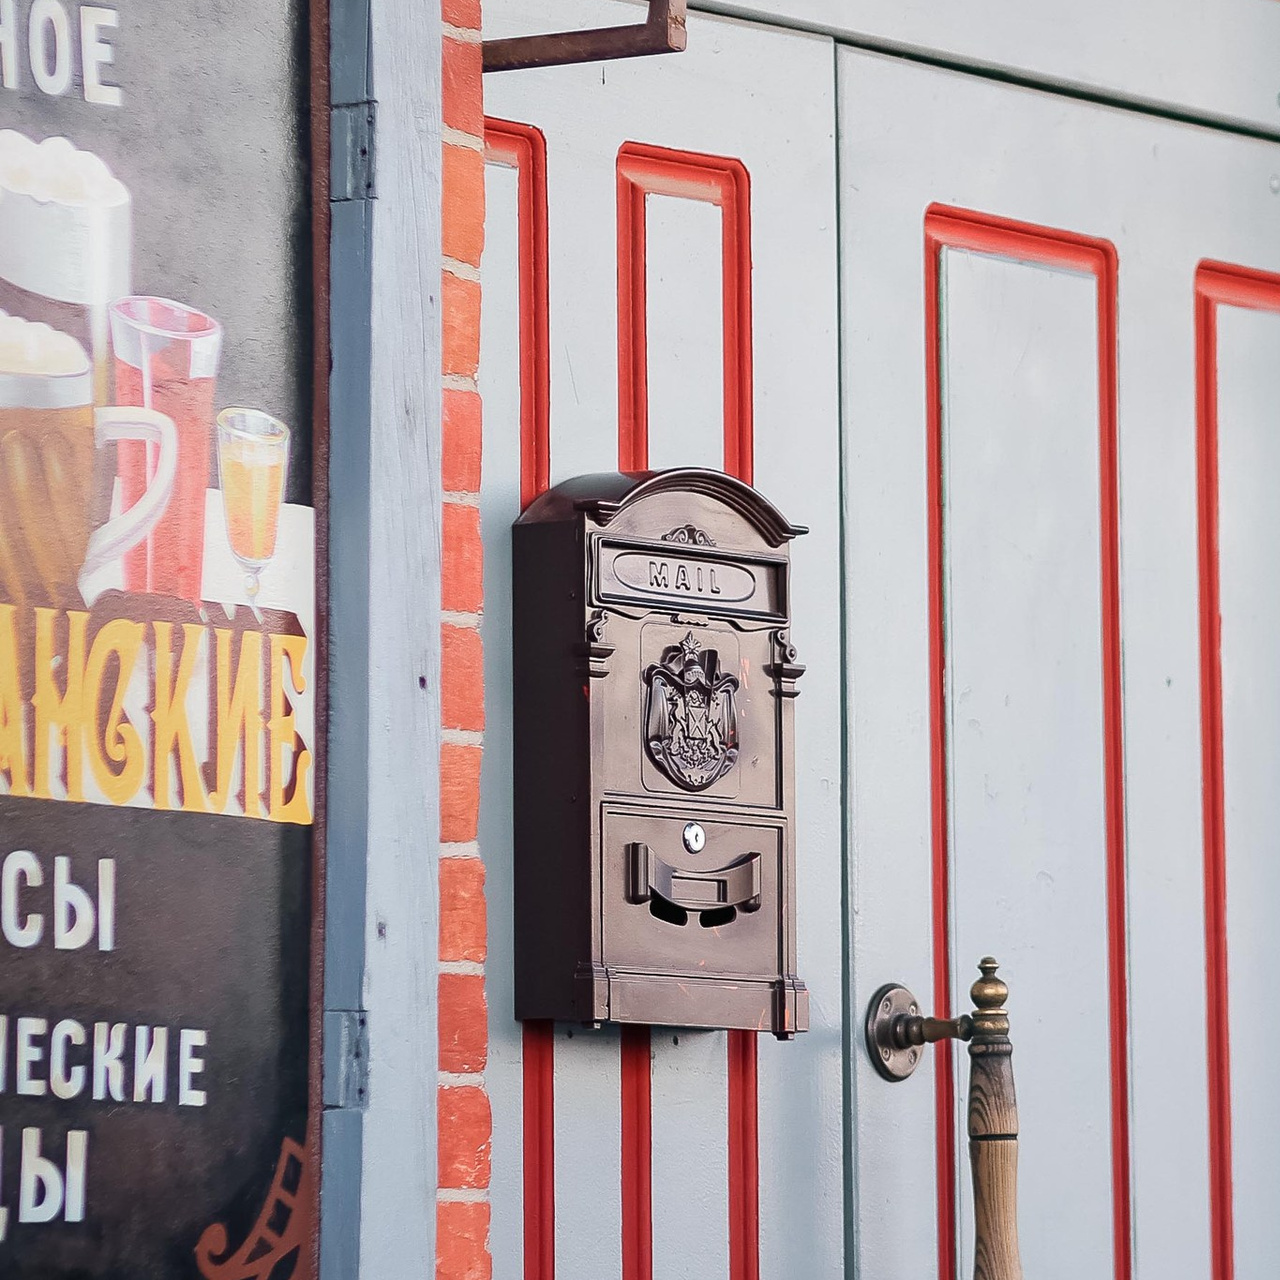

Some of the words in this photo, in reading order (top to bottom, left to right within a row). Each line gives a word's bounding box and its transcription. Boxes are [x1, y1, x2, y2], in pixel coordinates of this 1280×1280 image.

[648, 560, 721, 595] MAIL
[0, 1012, 208, 1108] ЕСКИЕ
[0, 1124, 89, 1242] Ы
